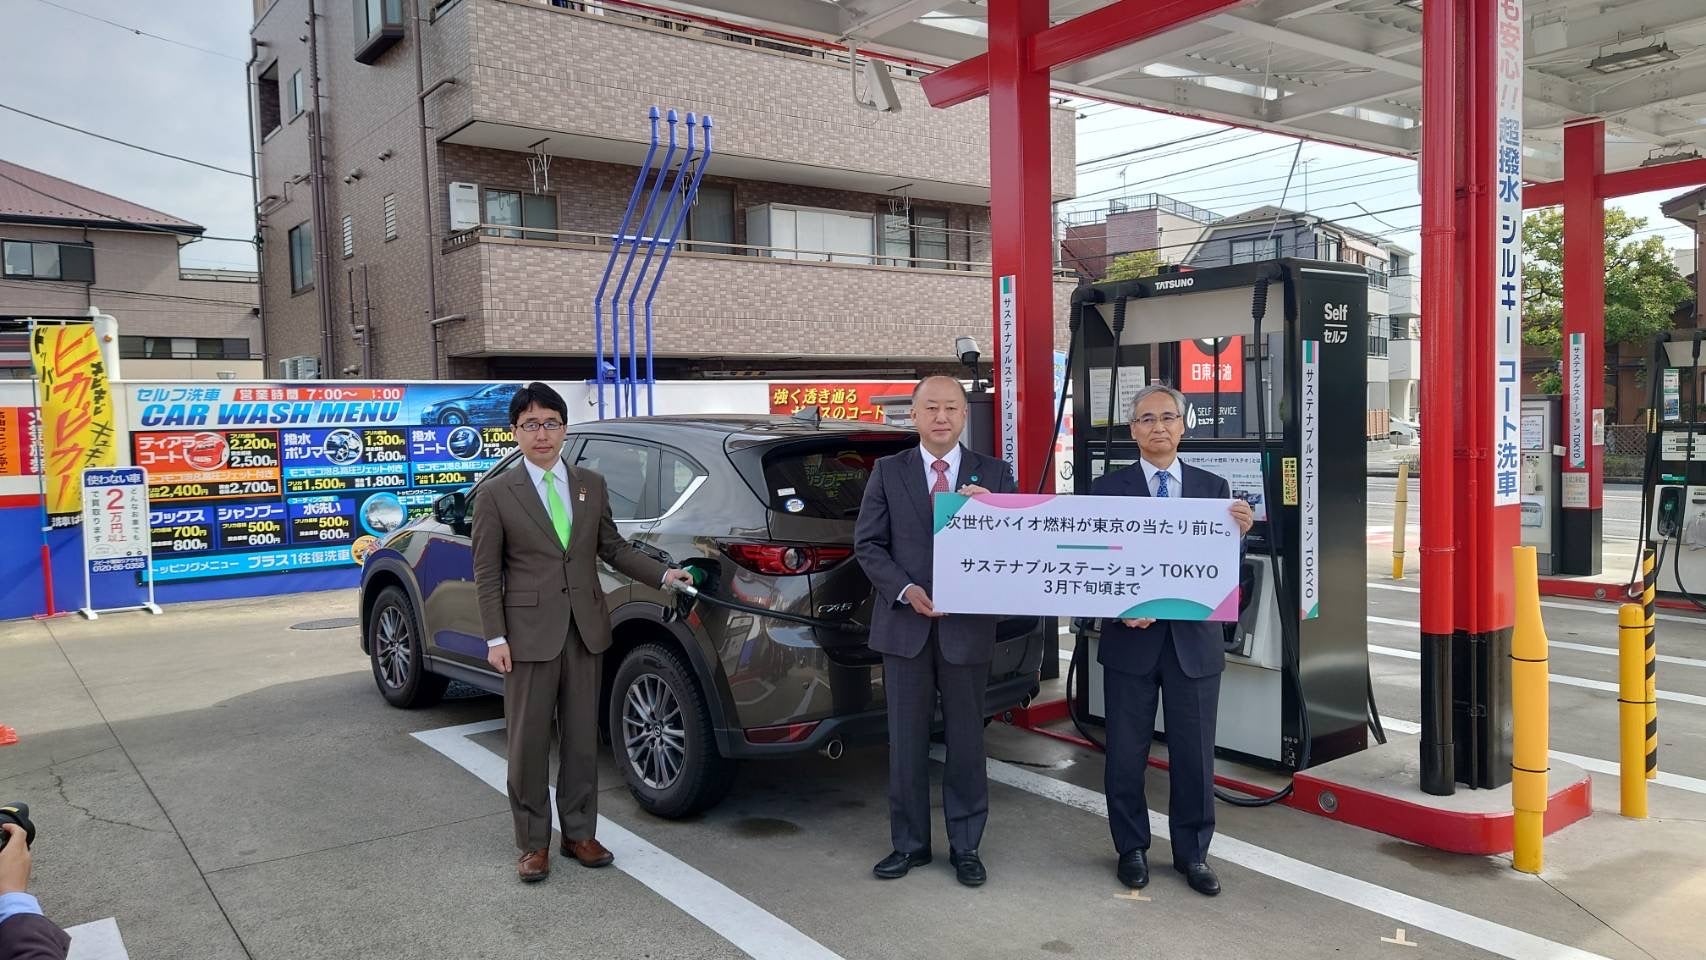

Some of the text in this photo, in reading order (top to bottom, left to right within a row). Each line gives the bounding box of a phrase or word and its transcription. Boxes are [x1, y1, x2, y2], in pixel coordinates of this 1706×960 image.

[1155, 277, 1194, 290] TATSUNO
[1501, 214, 1517, 345] シルキー
[1324, 302, 1348, 321] Self
[1323, 330, 1348, 344] セルフ
[1003, 297, 1014, 432] サステナブルステーション
[137, 388, 221, 401] セルフ洗車
[239, 388, 299, 401] 営業時間
[774, 387, 857, 405] 強く透き通る
[140, 401, 402, 427] CAR WASH MENU
[1197, 406, 1213, 416] SELF
[1497, 360, 1518, 497] コート洗車
[138, 436, 196, 449] ティアラ
[284, 433, 311, 446] 撥水
[364, 434, 406, 446] 1,300円
[412, 430, 436, 442] 撥水
[483, 432, 516, 442] 1,000
[230, 438, 277, 450] 2,200円
[413, 443, 446, 455] コート
[1573, 432, 1581, 458] TOKYO
[140, 451, 184, 464] コート
[285, 446, 336, 459] ポリマー
[365, 450, 407, 463] 1,600円
[231, 454, 278, 468] 2,500円
[87, 474, 141, 486] 使わない車
[303, 478, 346, 490] 1,500円
[365, 475, 405, 488] 1,800円
[428, 472, 467, 484] 1,200円
[1305, 368, 1314, 599] サステナブルステーション TOKYO
[160, 484, 209, 498] 2,400円
[229, 481, 276, 494] 2,700円
[217, 505, 284, 520] シャンプー
[303, 502, 342, 515] 水洗い
[150, 509, 206, 525] ワックス
[318, 516, 350, 528] 500円
[173, 525, 208, 538] 700円
[247, 521, 280, 532] 500円
[945, 514, 1232, 537] 次世代バイオ燃料が東京の当たり前に。
[248, 533, 281, 545] 600円
[319, 528, 350, 540] 600円
[173, 538, 208, 551] 800円
[961, 558, 1219, 579] サステナブルステーション TOKYO
[1044, 579, 1141, 596] 3月下旬頃まで
